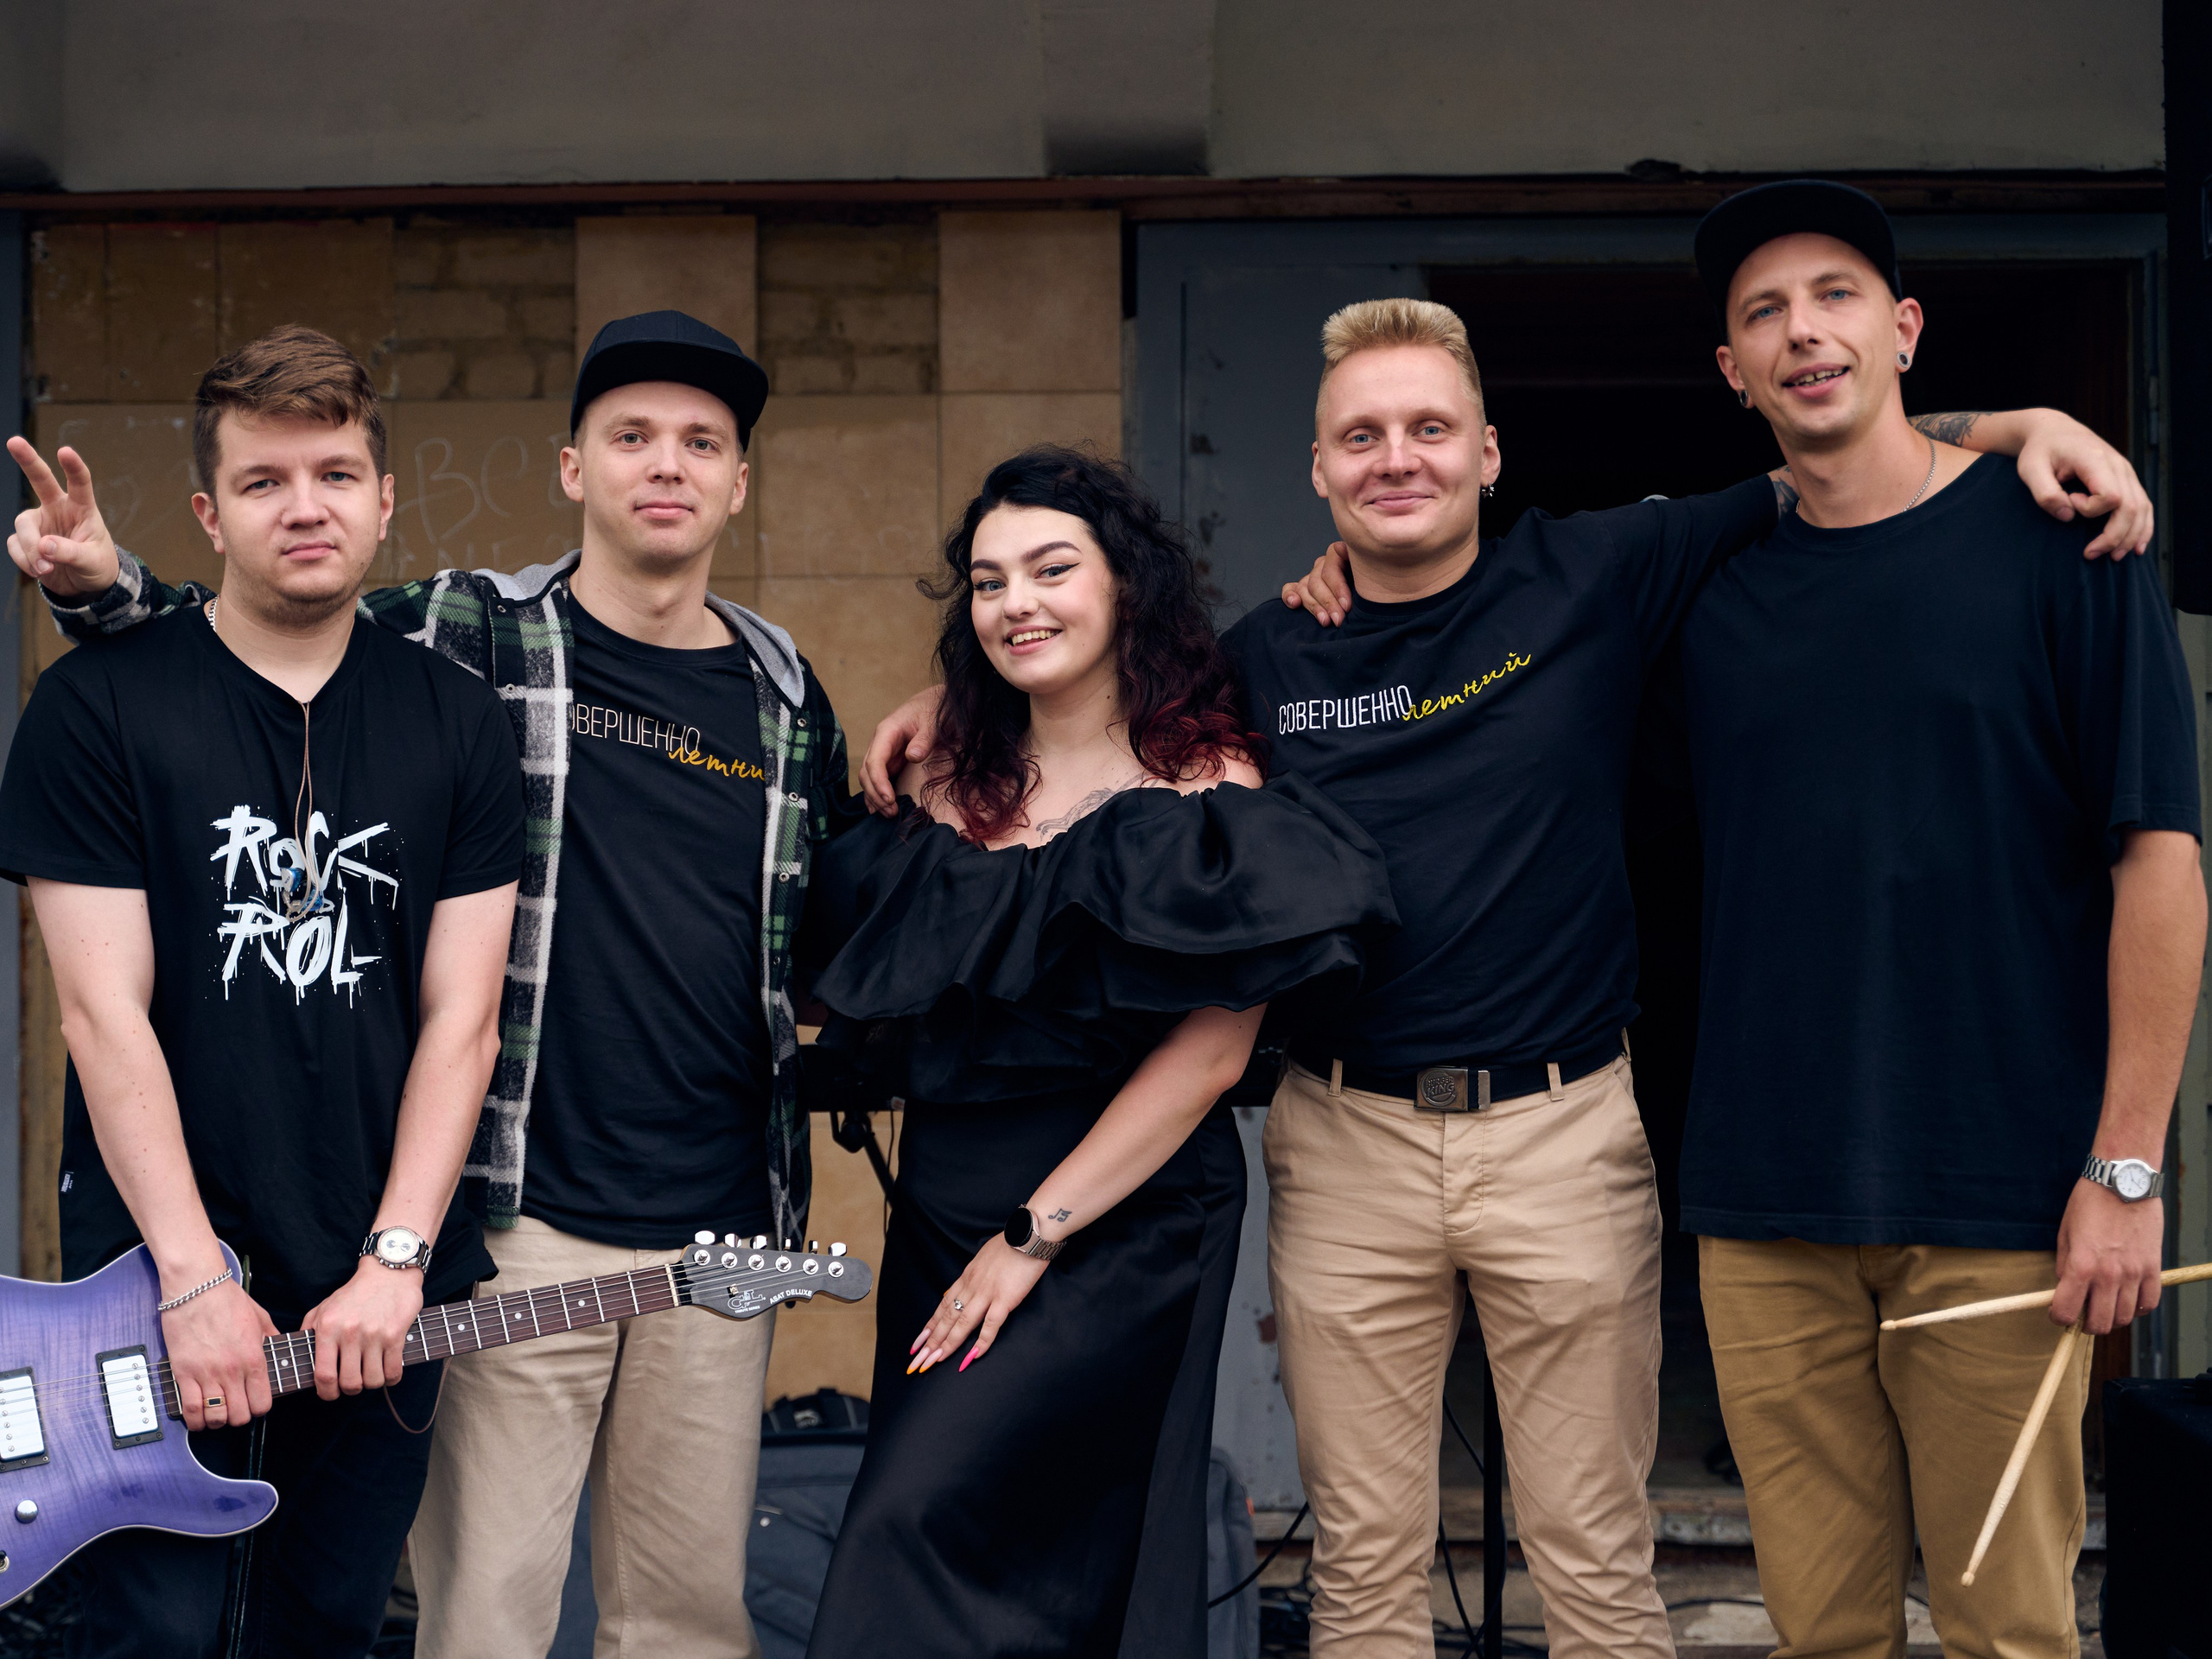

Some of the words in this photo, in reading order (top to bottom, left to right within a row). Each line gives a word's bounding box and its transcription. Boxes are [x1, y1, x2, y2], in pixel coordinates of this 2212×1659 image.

[572, 703, 701, 756] ВЕРШЕННО
[1279, 685, 1412, 735] СОВЕРШЕННО
[210, 804, 399, 909] ROCK
[1427, 1083, 1454, 1097] KING
[785, 1288, 812, 1297] DELUXE
